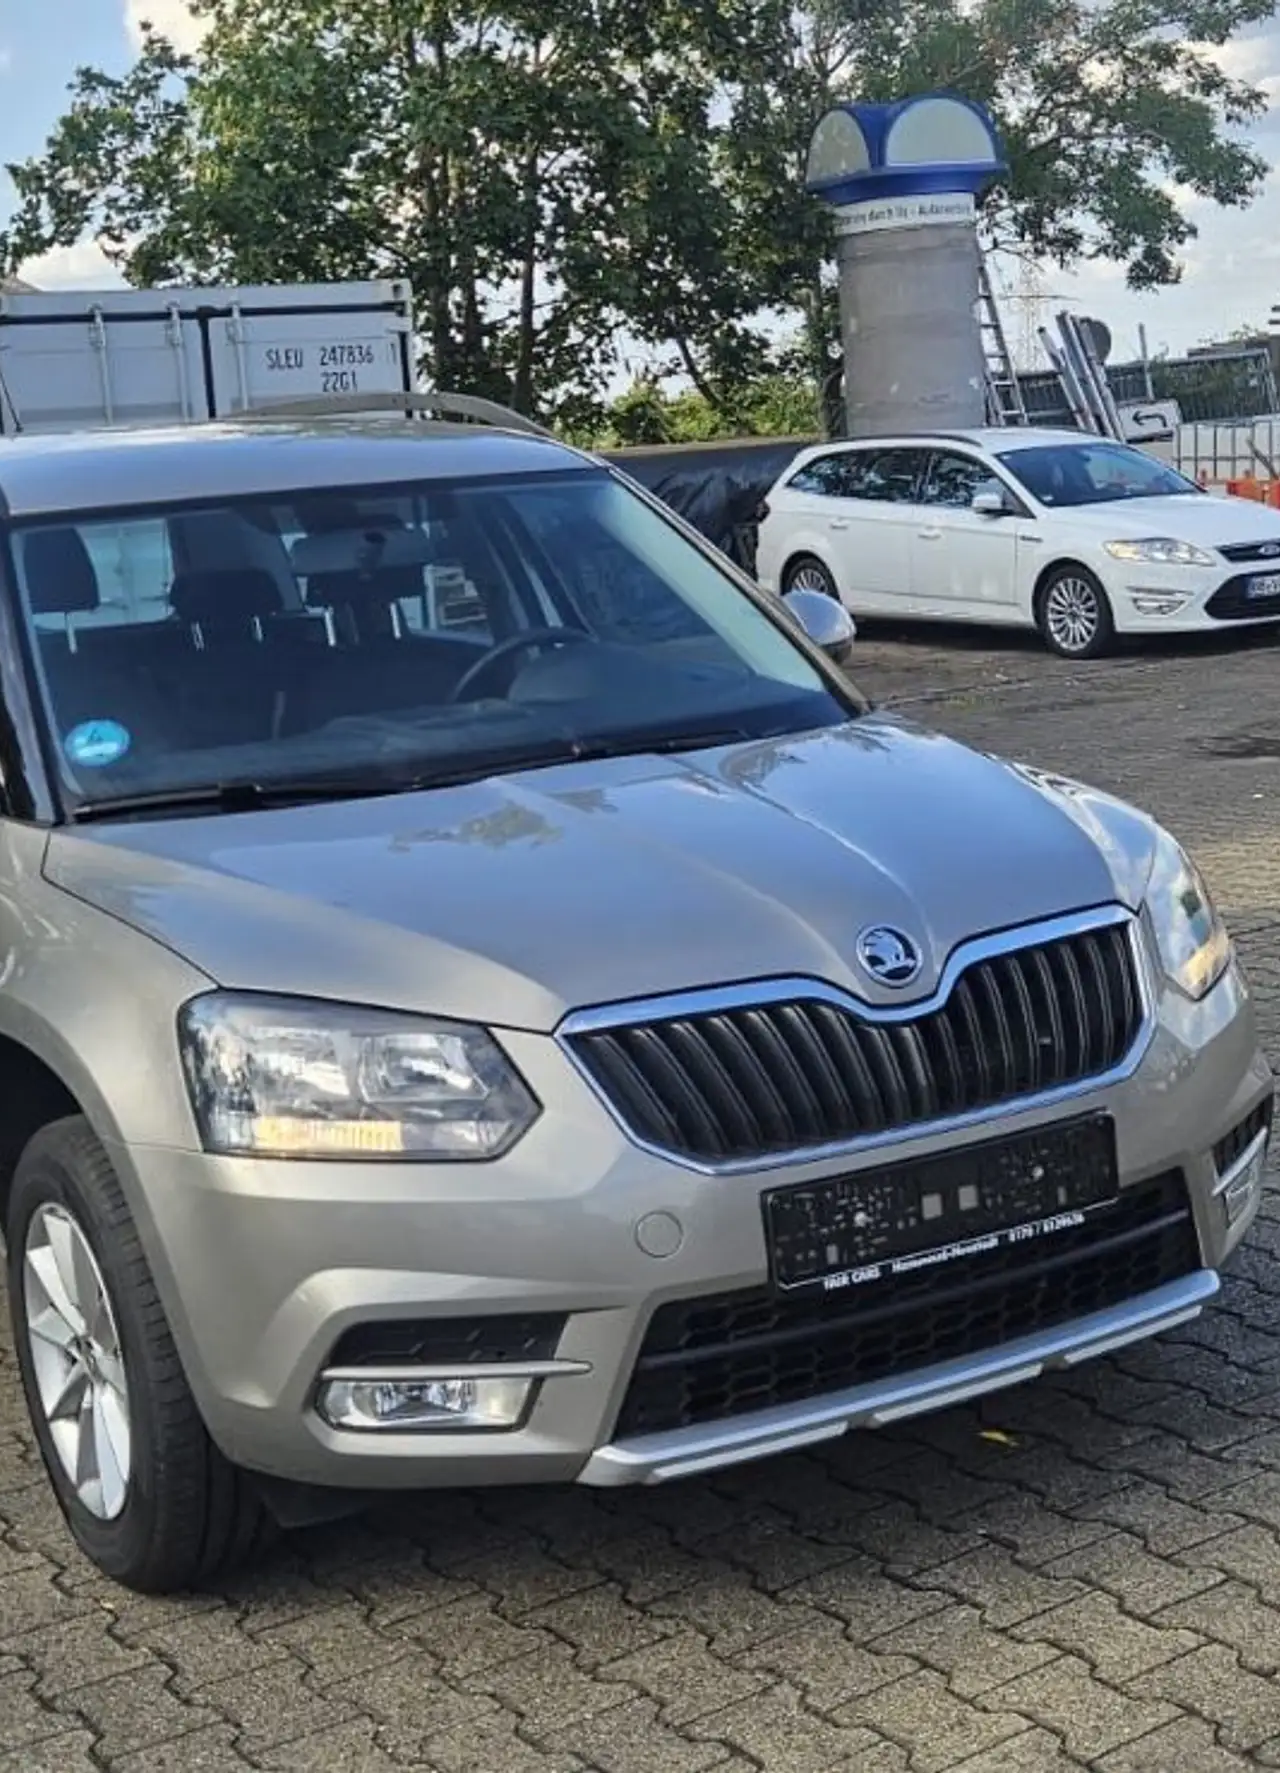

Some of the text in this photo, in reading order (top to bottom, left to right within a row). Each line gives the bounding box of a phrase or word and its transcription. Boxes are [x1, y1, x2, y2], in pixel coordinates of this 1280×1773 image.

[265, 347, 304, 370] SLEU
[319, 343, 375, 366] 247836
[321, 371, 358, 393] 22G1
